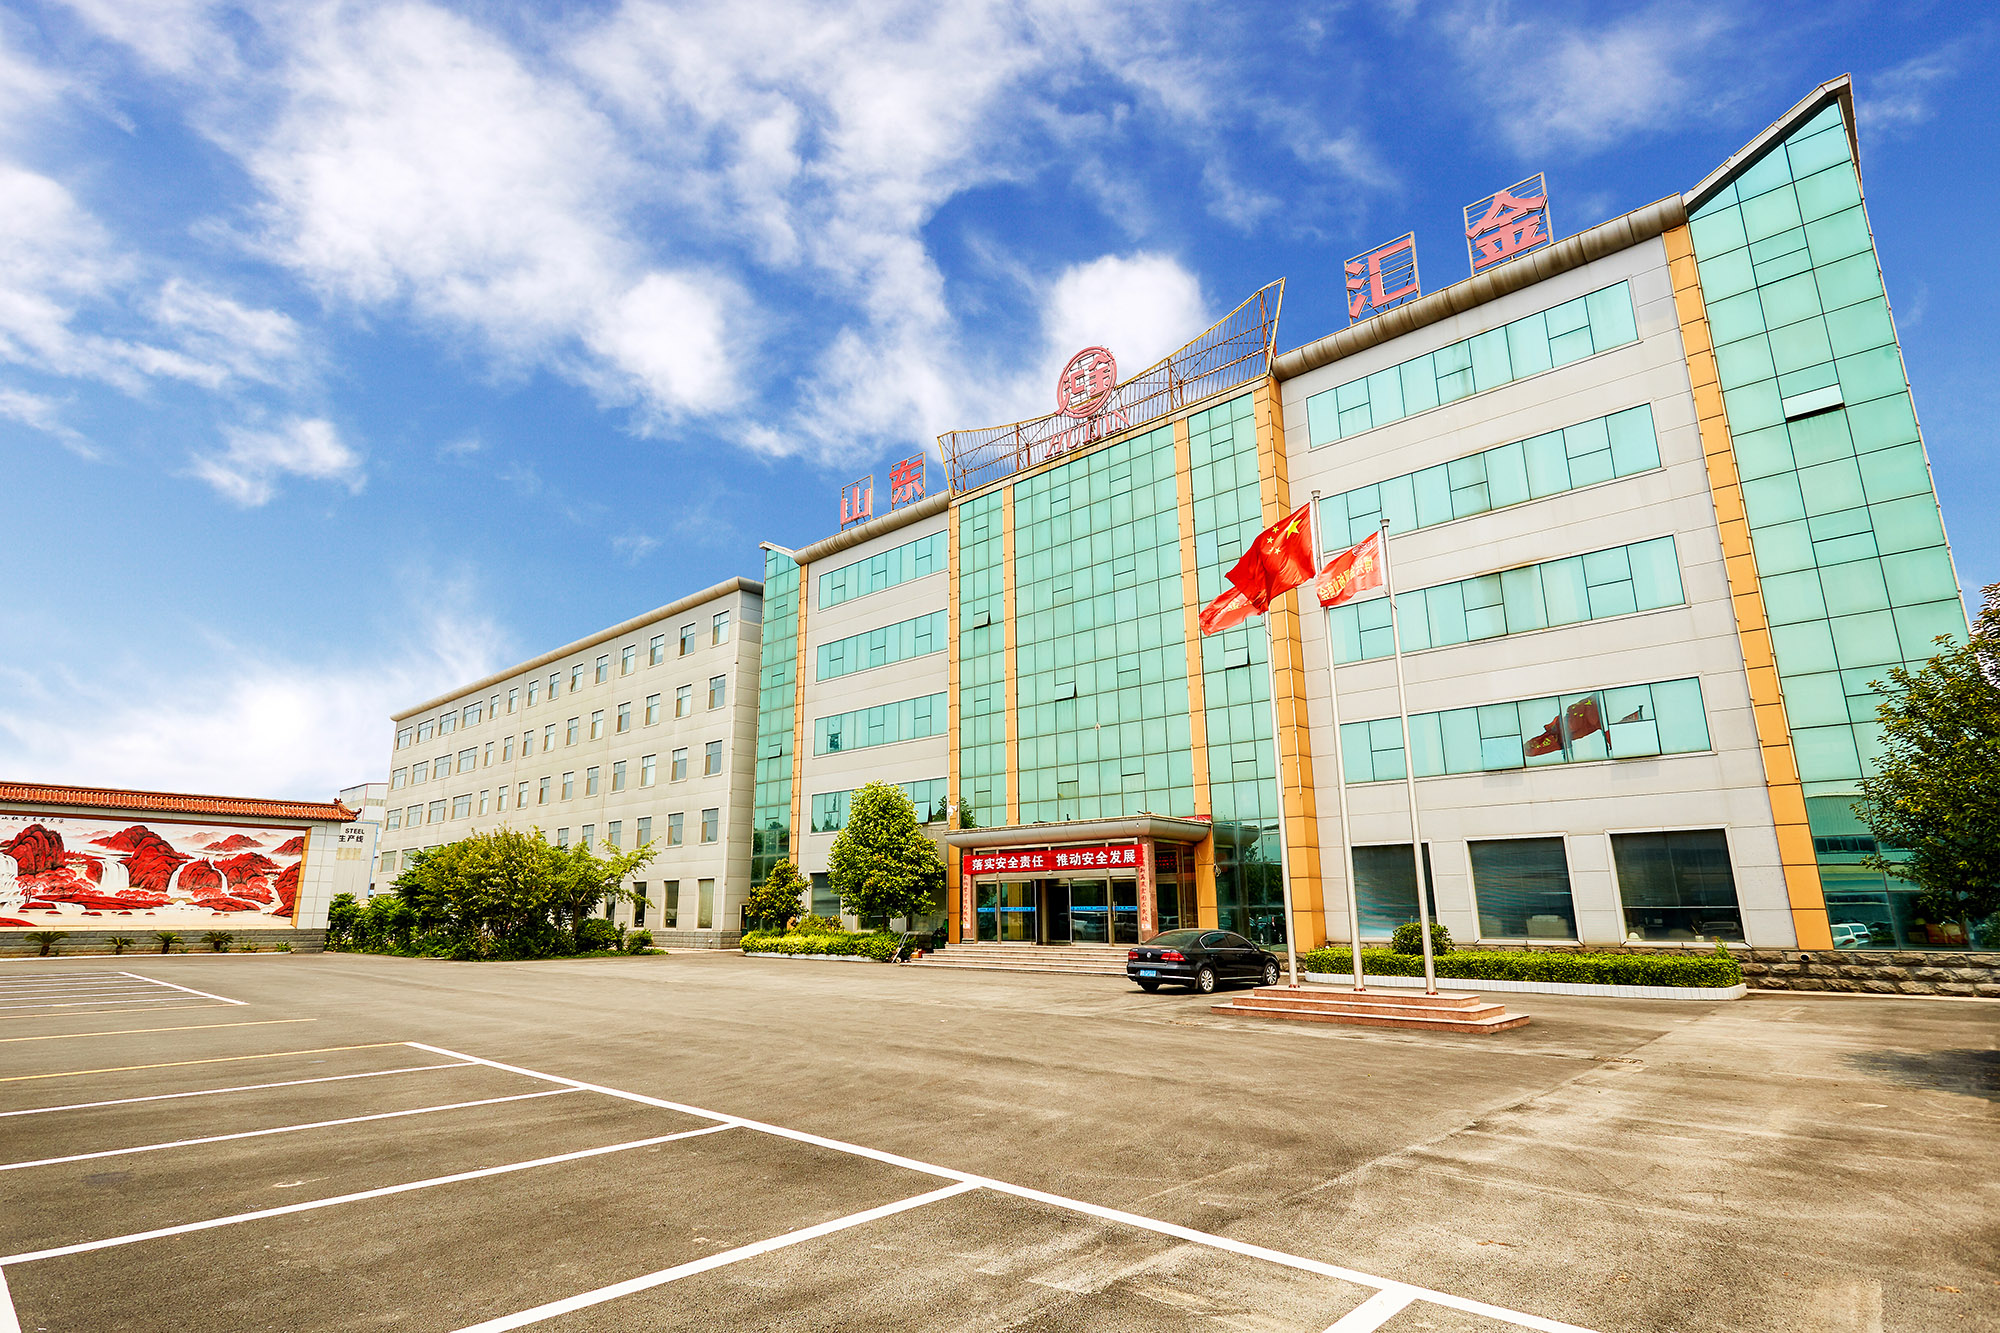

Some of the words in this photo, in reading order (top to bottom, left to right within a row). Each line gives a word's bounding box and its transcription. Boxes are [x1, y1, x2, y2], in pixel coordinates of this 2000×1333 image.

[840, 459, 925, 525] 山东
[1345, 191, 1548, 319] 汇金
[1045, 406, 1130, 458] HUIJIN
[338, 835, 364, 843] 生产线
[972, 855, 1044, 871] 落实安全责任
[1056, 849, 1136, 867] 推动安全发展
